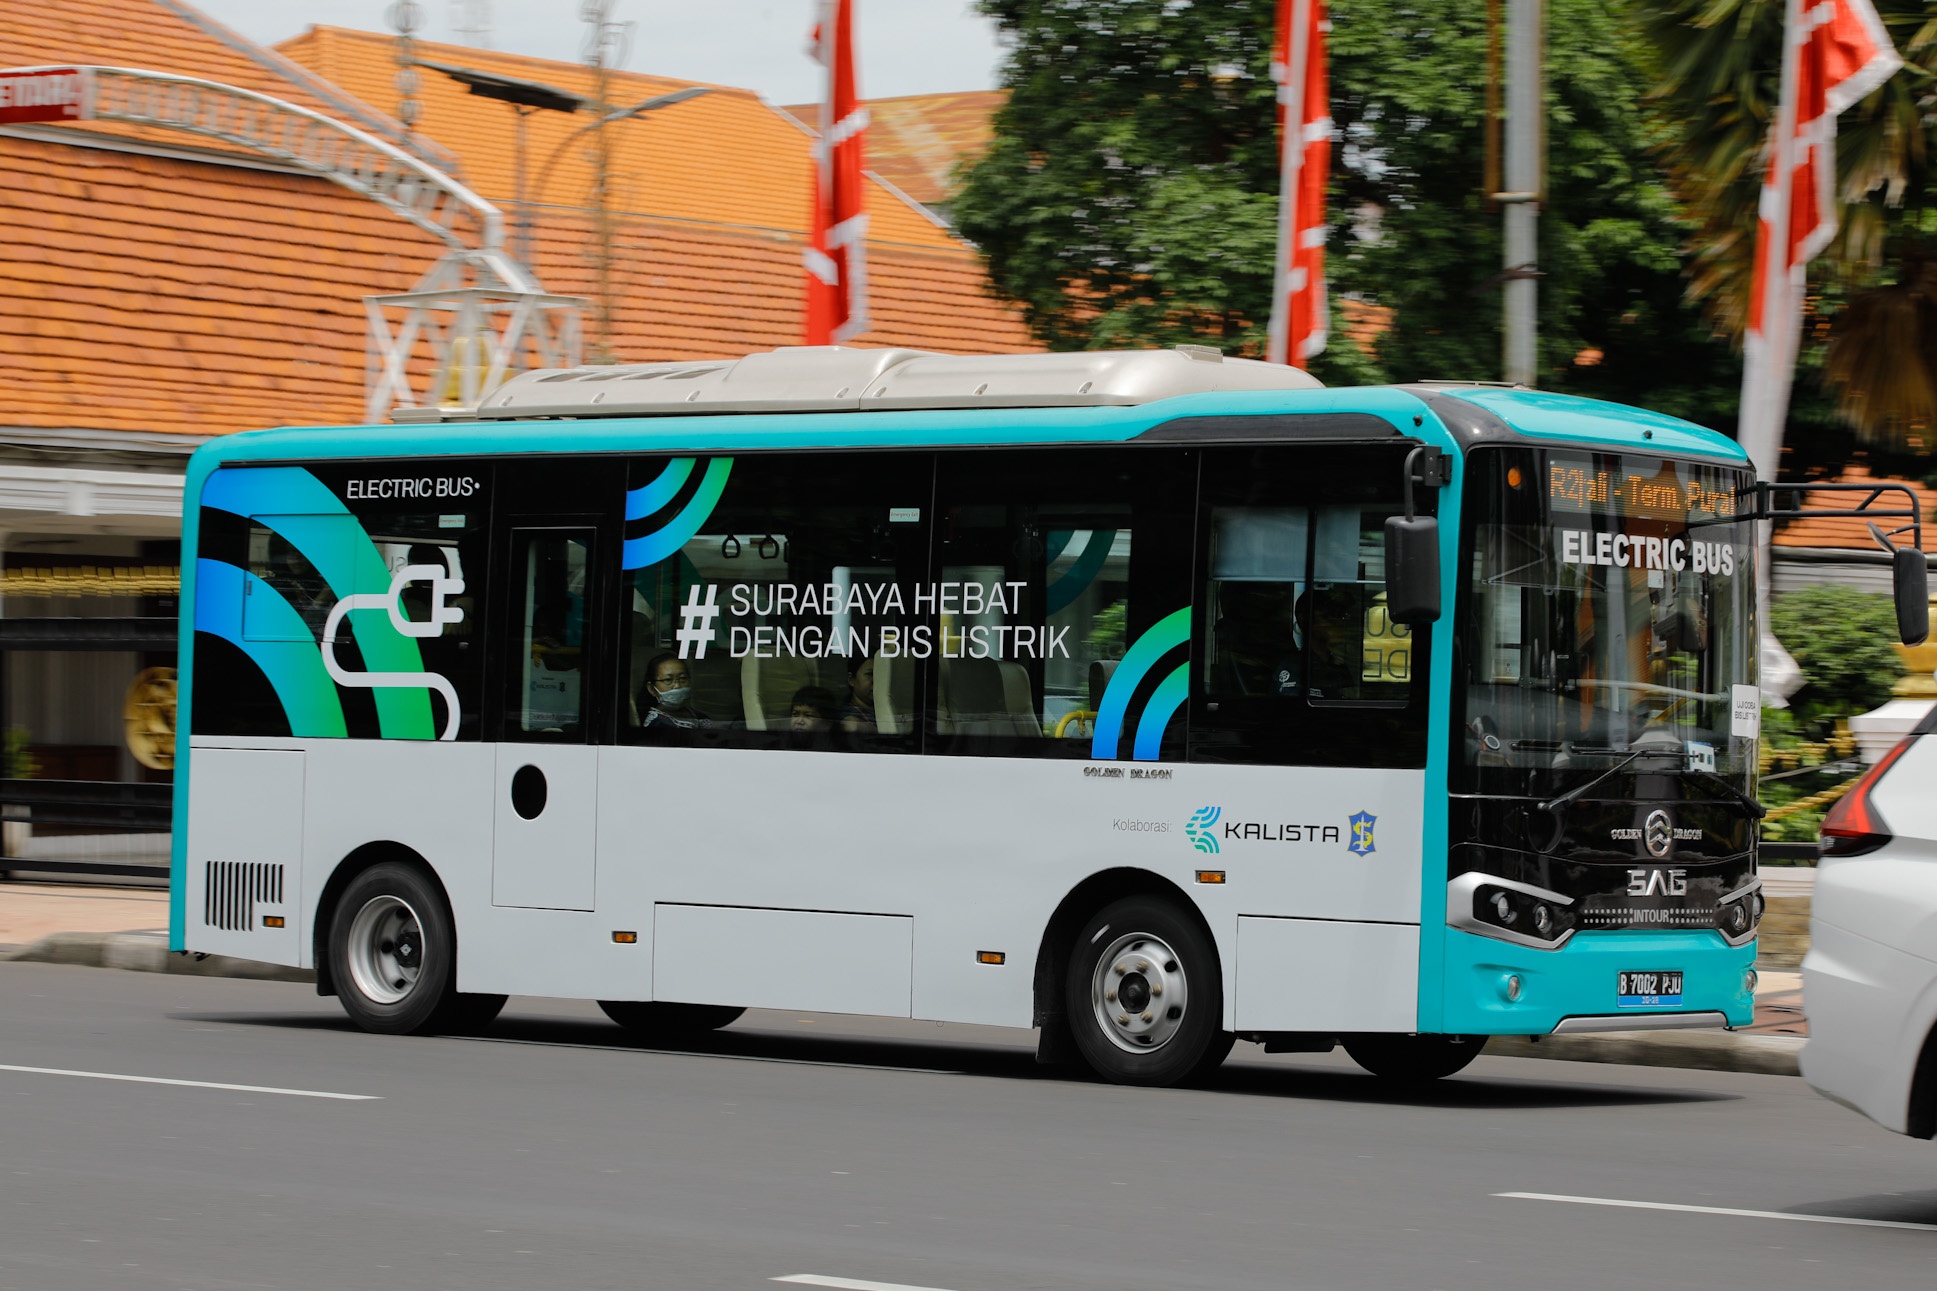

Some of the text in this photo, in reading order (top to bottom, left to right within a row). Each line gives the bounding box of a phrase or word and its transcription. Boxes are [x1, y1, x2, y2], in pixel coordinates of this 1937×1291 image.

[346, 478, 433, 499] ELECTRIC
[1562, 530, 1734, 576] ELECTRIC BUS
[730, 581, 1028, 616] SURABAYA HEBAT
[730, 625, 1071, 659] DENGAN BIS LISTRIK
[1083, 766, 1173, 779] GOLDEN DRAGON
[1113, 818, 1340, 843] Kolaborasi: KALISTA
[1610, 828, 1703, 841] GOLDEN DRAGON
[1633, 909, 1670, 923] INTOUR
[1619, 973, 1682, 995] B 7002 PJU
